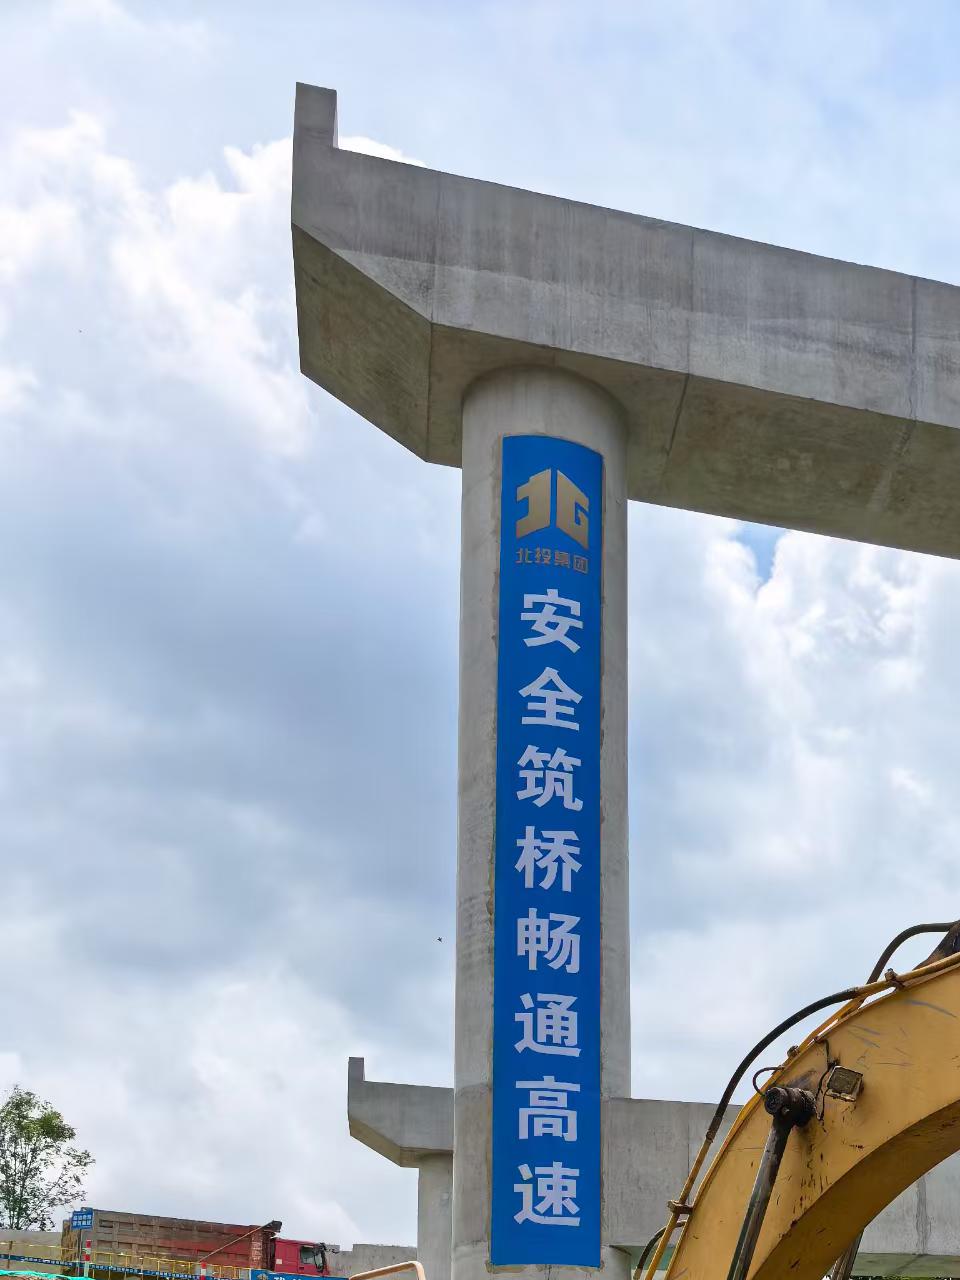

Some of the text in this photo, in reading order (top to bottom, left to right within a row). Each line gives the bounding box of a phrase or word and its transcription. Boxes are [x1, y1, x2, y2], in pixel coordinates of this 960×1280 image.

[515, 547, 589, 574] 北投集团
[514, 588, 584, 1227] 安全筑桥畅通高速
